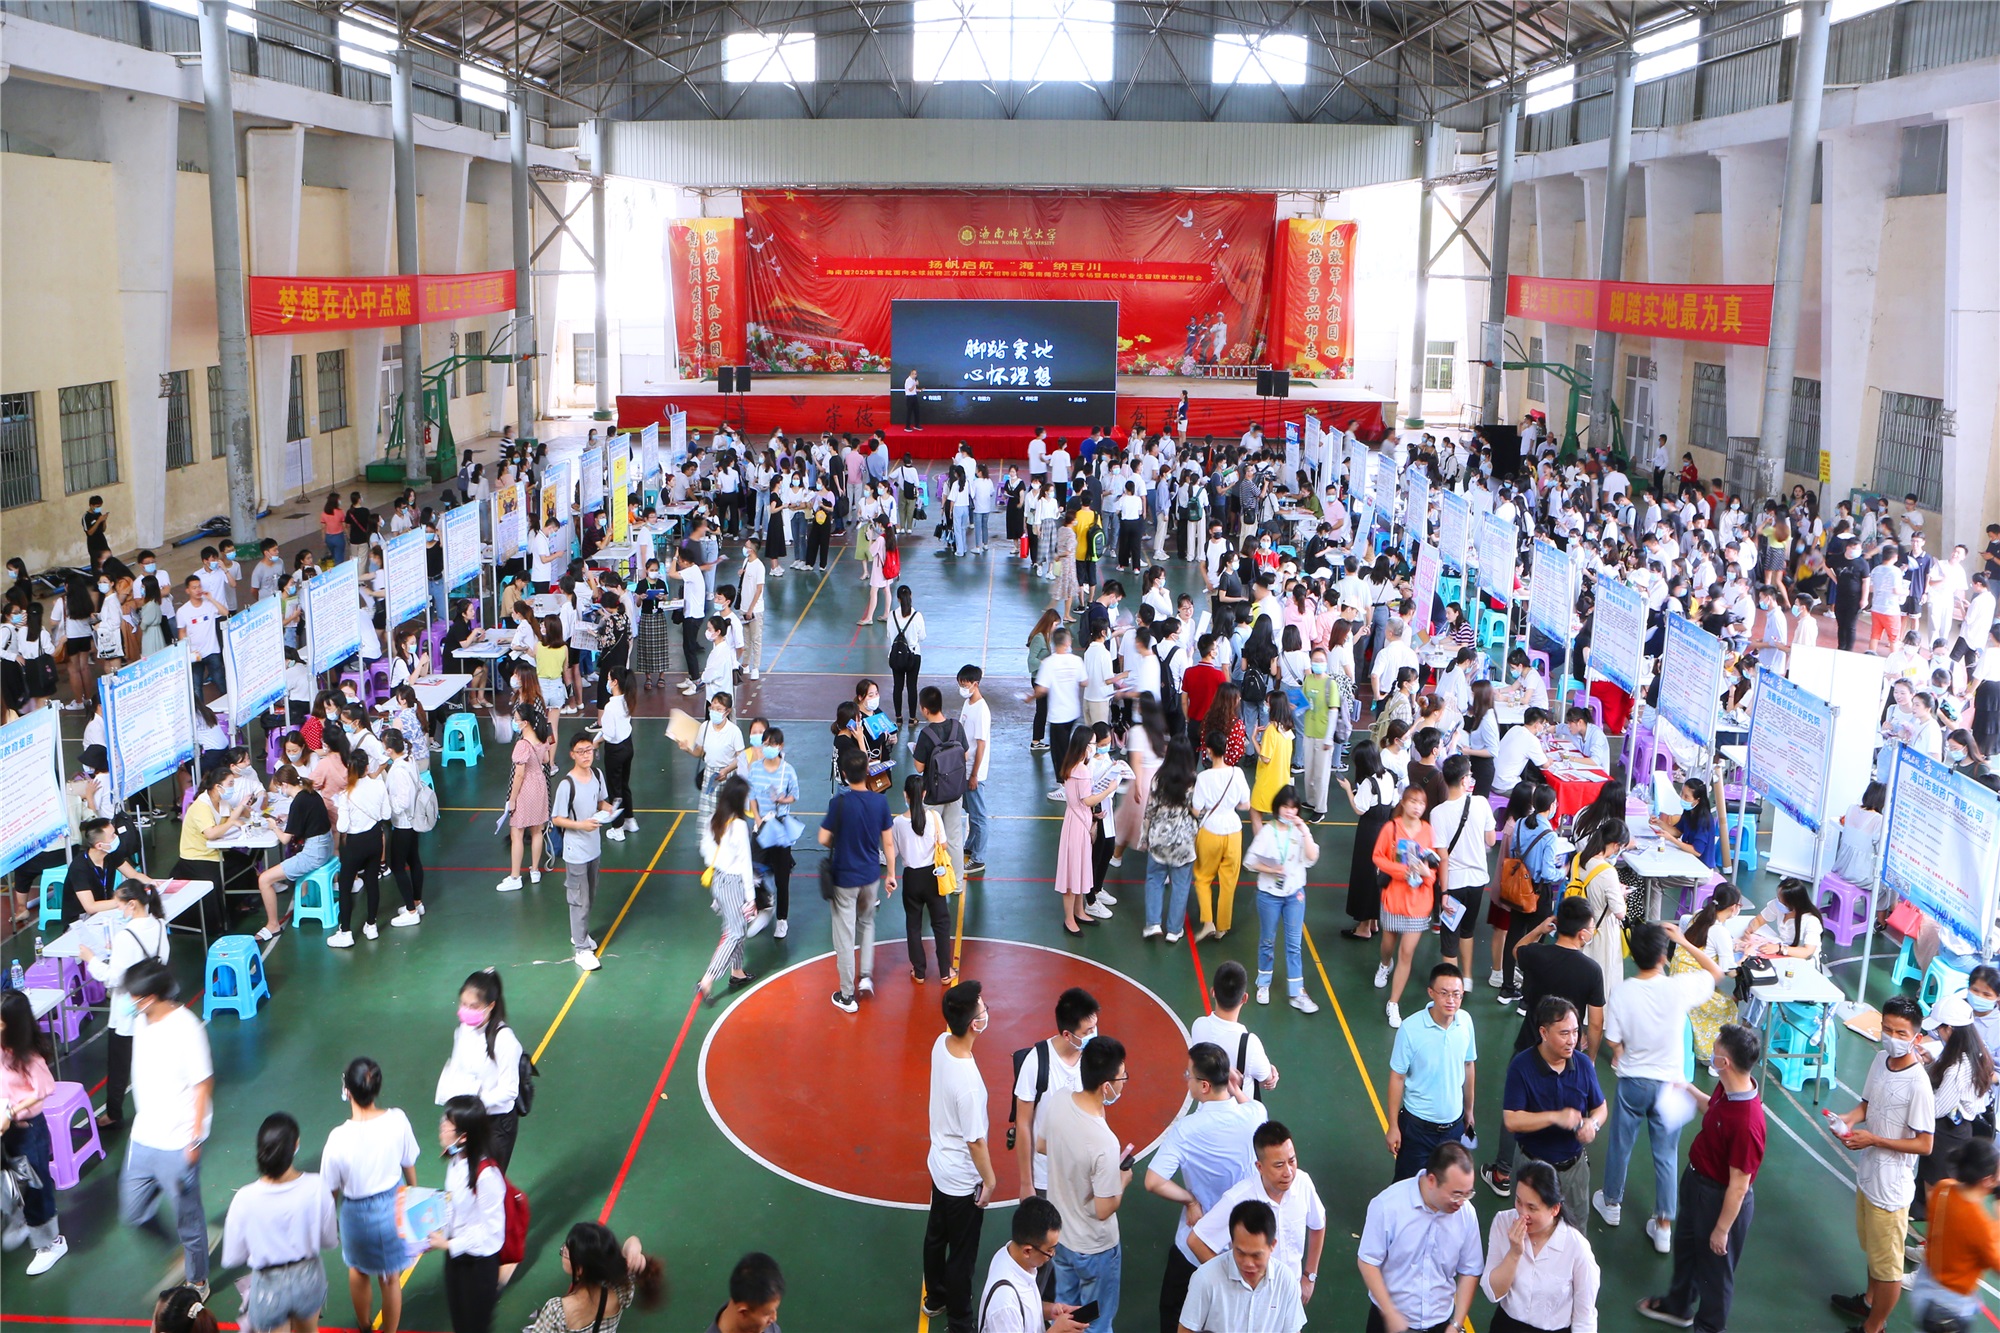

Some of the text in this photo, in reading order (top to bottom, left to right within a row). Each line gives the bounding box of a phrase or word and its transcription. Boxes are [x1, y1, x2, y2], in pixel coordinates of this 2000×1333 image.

[979, 225, 1057, 241] 海南师范大学
[928, 259, 994, 270] 扬帆启航
[278, 284, 411, 324] 梦想在心中点燃
[704, 230, 722, 358] 纵横天下绘宏图
[1304, 230, 1323, 359] 欲培学子兴邦志
[1325, 230, 1345, 358] 先效军人报国心
[1609, 291, 1743, 333] 脚踏实地最为真
[964, 338, 1054, 361] 脚踏实地
[963, 364, 1053, 387] 心怀理想
[1909, 769, 1985, 823] 海口市制药厂有限公司
